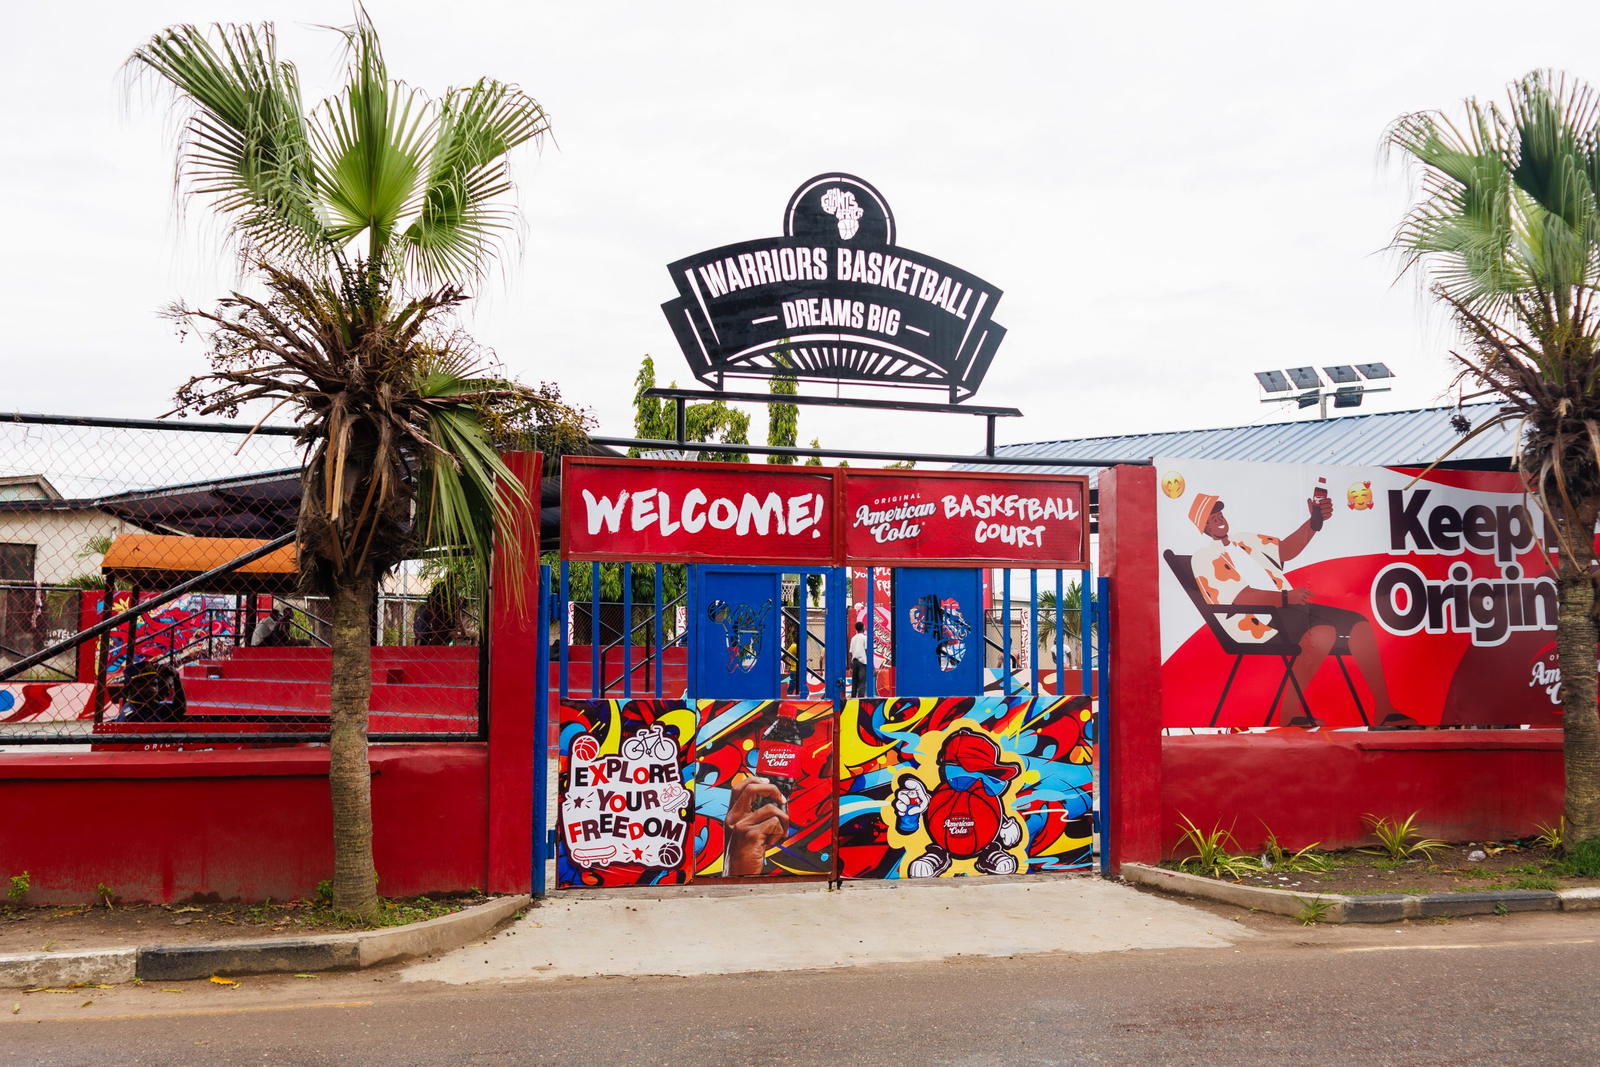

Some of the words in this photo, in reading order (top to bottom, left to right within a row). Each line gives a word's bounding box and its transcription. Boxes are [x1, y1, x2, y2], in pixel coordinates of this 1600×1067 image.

[699, 247, 828, 299] WARRIORS
[837, 248, 973, 320] BASKETBALL
[782, 298, 864, 330] DREAMS
[867, 308, 901, 337] BIG
[874, 493, 921, 505] ORIGINAL
[941, 493, 1079, 521] BASKETBALL
[581, 487, 824, 540] WELCOME!
[853, 502, 937, 528] American
[1387, 489, 1533, 562] Keep
[870, 520, 921, 544] Cola
[975, 520, 1046, 548] COURT
[575, 759, 677, 786] EXPLORE
[767, 759, 789, 767] Cola
[597, 789, 660, 813] YOUR
[568, 814, 683, 844] FREEDOM
